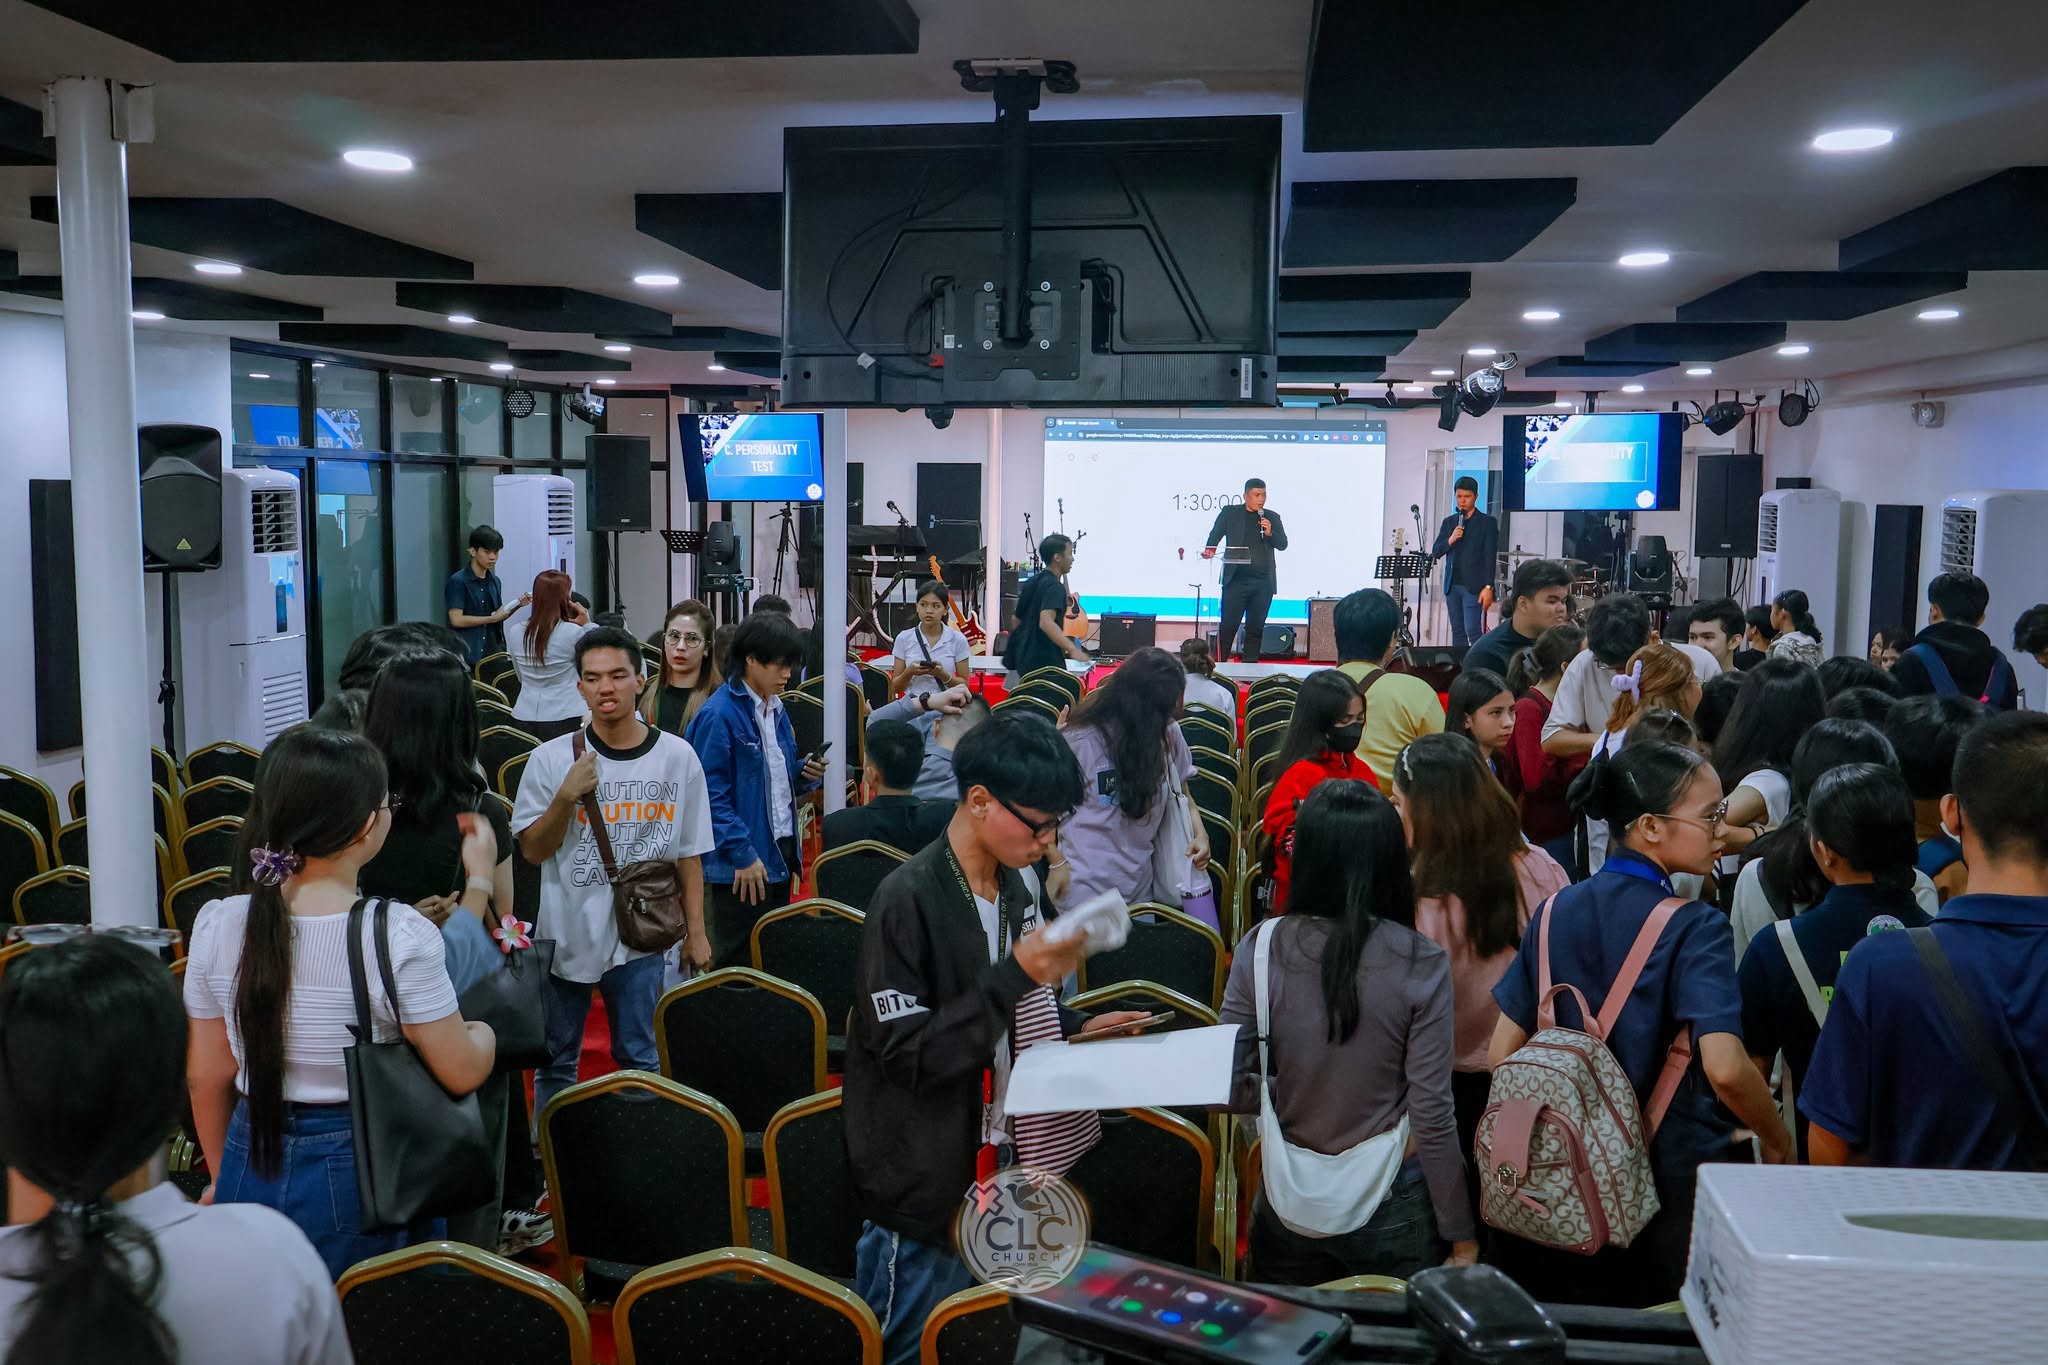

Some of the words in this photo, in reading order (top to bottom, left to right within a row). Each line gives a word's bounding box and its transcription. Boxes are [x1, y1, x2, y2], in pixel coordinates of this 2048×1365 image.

[724, 444, 733, 456] C.
[736, 443, 798, 456] PERSONALITY
[751, 460, 774, 473] TEST
[577, 802, 675, 825] CUTION
[999, 913, 1007, 950] INSTITUTE
